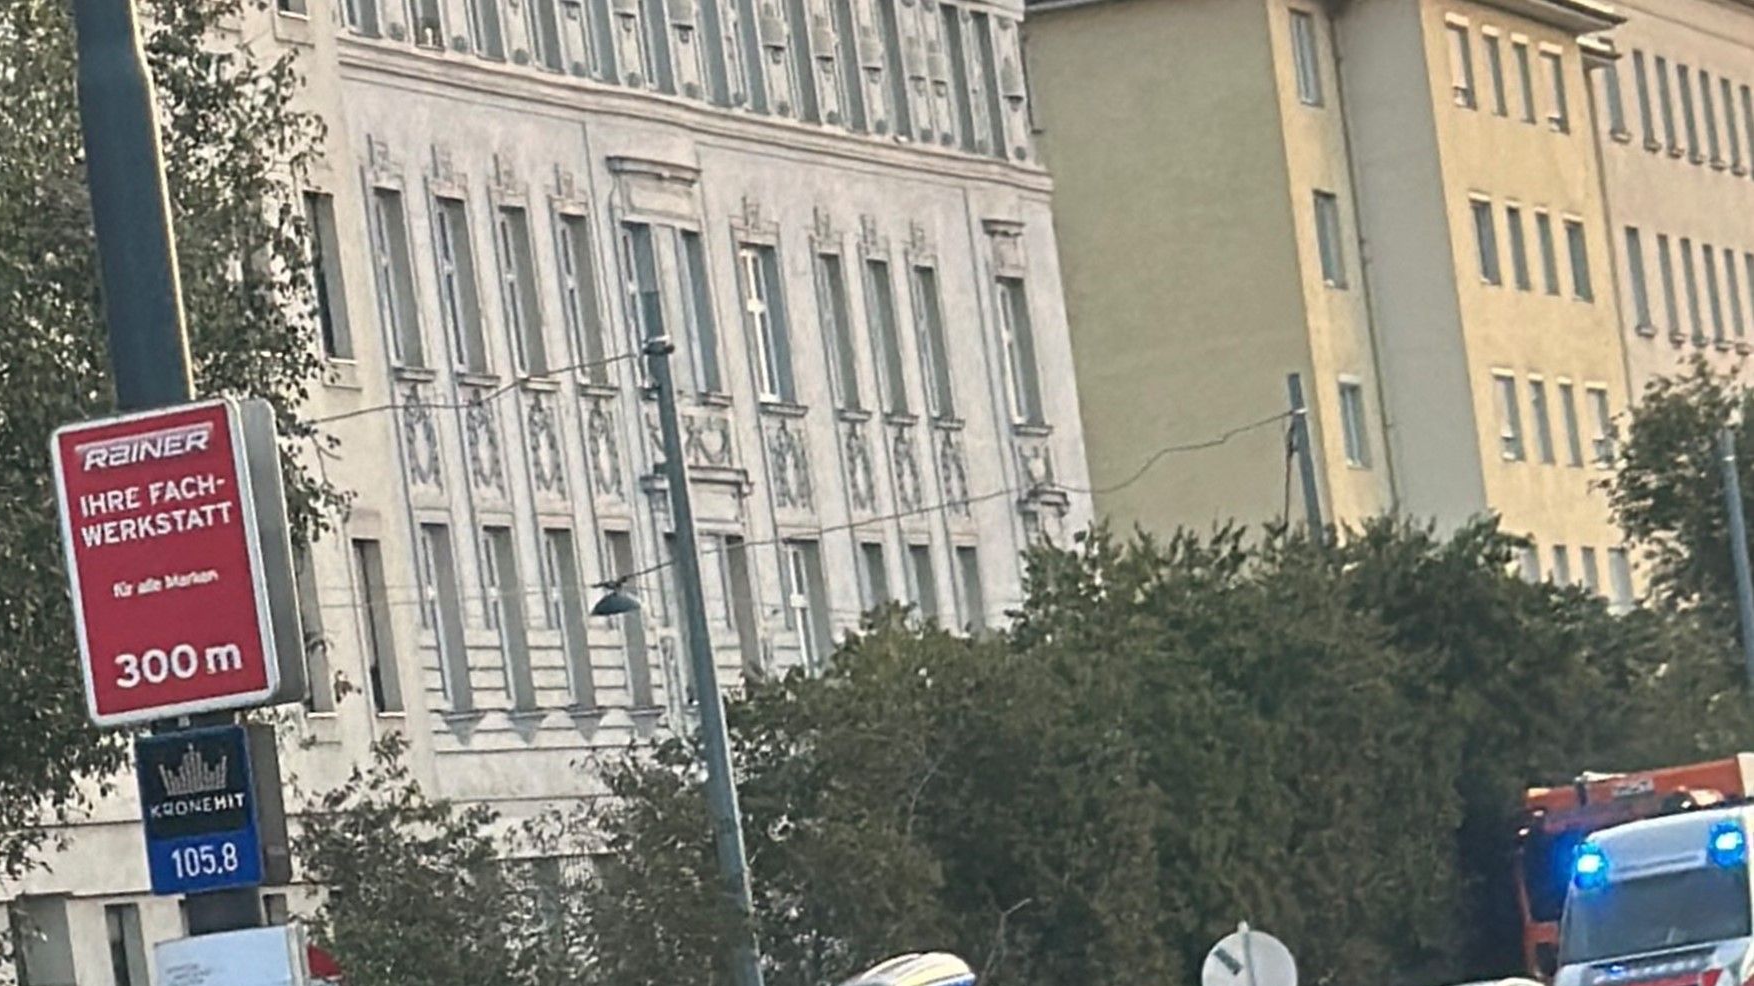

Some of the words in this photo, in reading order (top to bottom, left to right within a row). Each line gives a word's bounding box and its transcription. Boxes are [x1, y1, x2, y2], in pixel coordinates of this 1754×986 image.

[80, 487, 142, 518] IHRE
[148, 474, 226, 505] FACH-
[81, 501, 233, 548] WERKSTATT
[113, 581, 133, 598] für
[137, 578, 162, 594] alle
[164, 569, 219, 589] Marken
[114, 643, 199, 688] 300
[204, 643, 243, 675] m
[150, 792, 245, 818] KRONEHIT
[171, 842, 238, 879] 105.8
